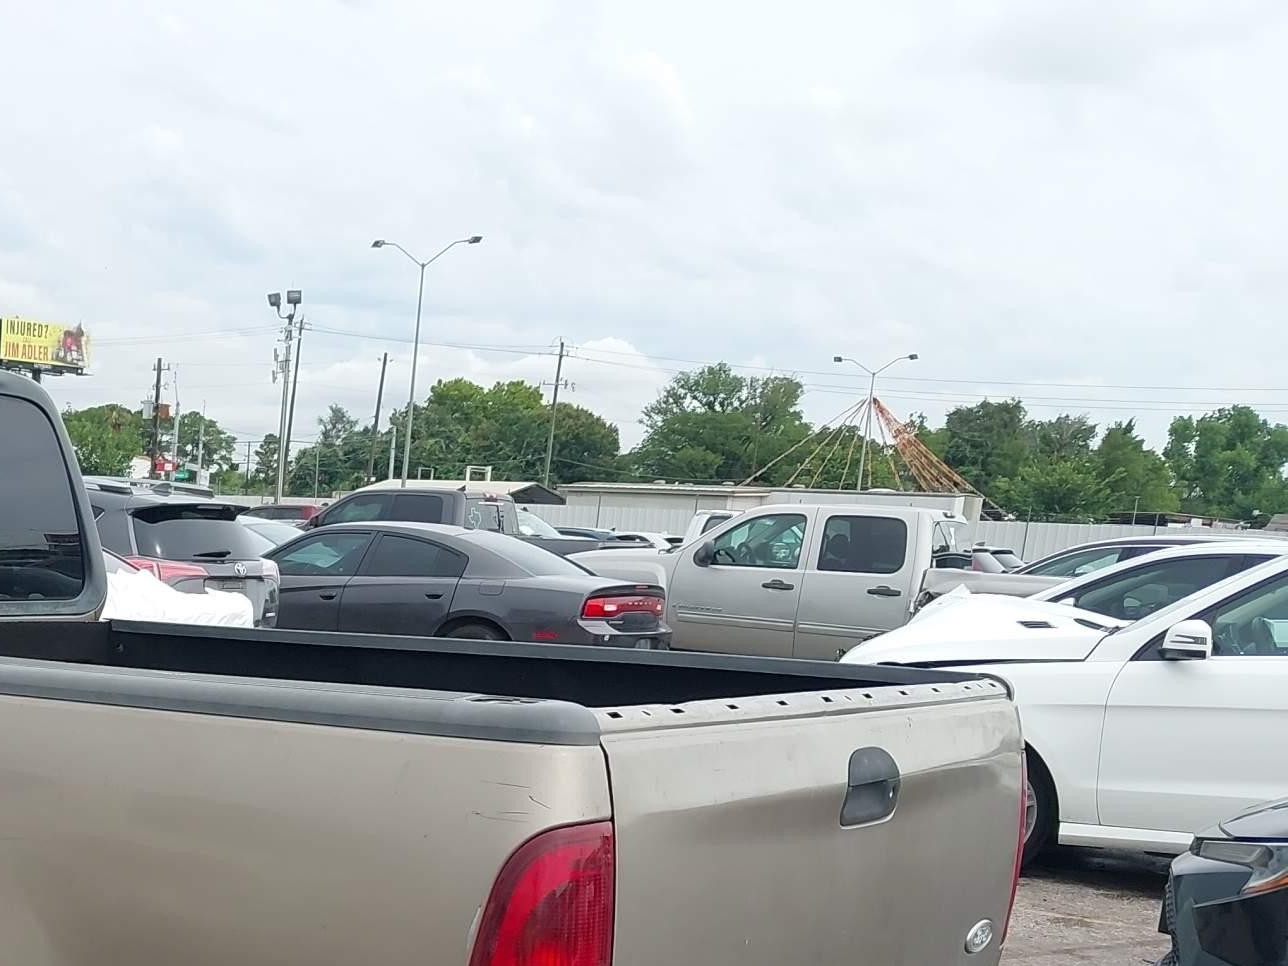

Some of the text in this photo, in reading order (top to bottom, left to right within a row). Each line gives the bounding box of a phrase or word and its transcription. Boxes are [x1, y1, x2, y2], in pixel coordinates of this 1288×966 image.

[6, 319, 49, 339] INJURED?
[4, 341, 49, 361] JIM ADLER
